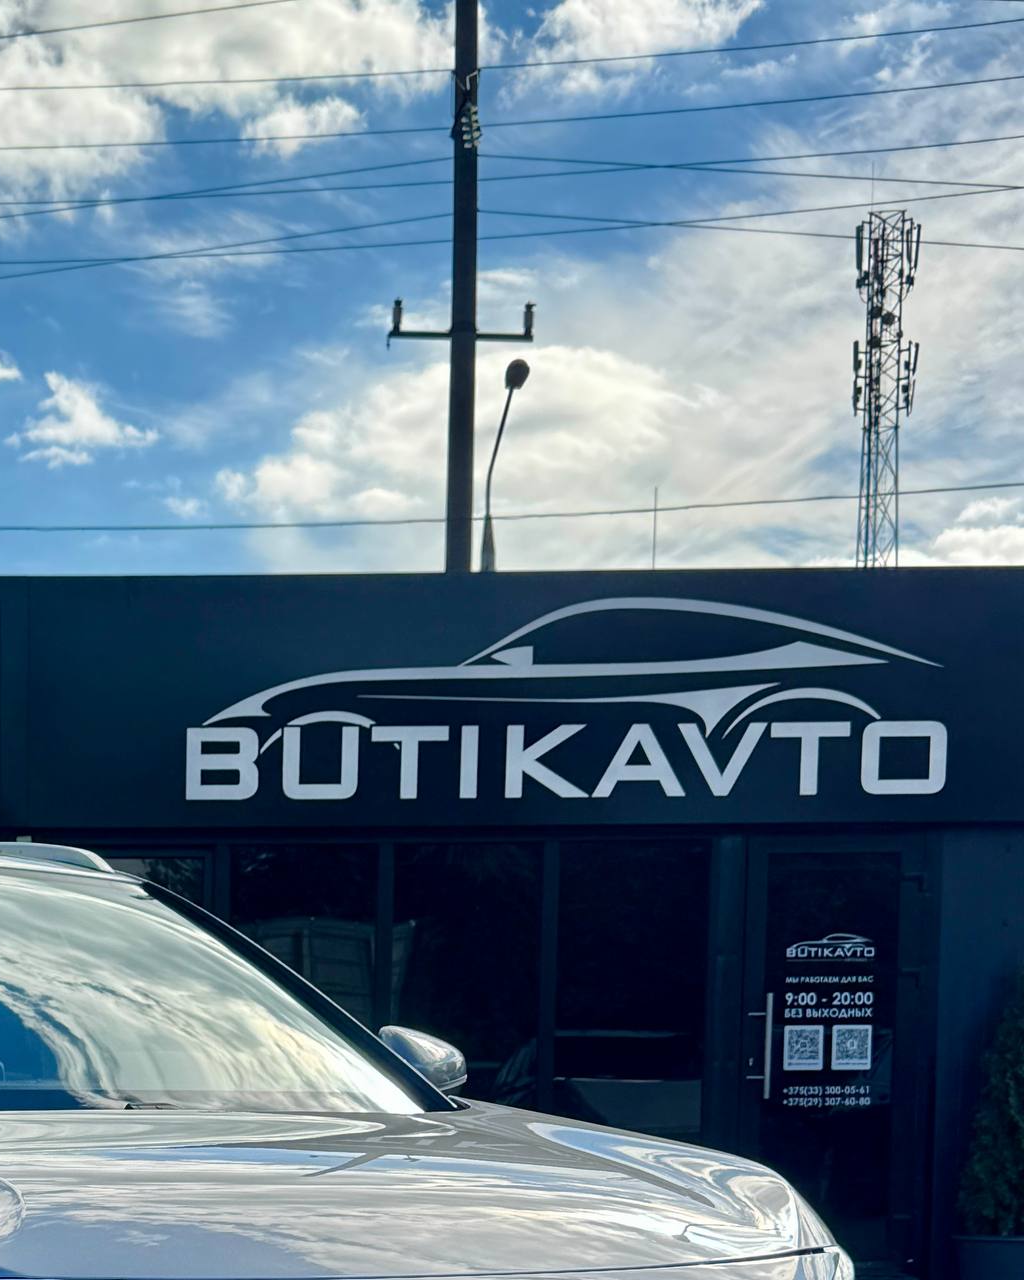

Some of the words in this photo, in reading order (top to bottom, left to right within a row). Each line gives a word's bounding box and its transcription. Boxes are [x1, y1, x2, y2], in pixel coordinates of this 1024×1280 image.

[185, 718, 948, 801] BUTIKAVTO
[786, 946, 875, 958] BUTIKAVTO
[785, 976, 800, 984] МЫ
[800, 976, 839, 984] РАБОТАЕМ
[857, 975, 874, 983] ВАС
[785, 992, 817, 1006] 9:00
[831, 991, 874, 1006] 20:00
[784, 1008, 803, 1018] БЕЗ
[805, 1007, 873, 1019] ВЫХОДНЫХ
[783, 1086, 823, 1096] +375(33)
[824, 1085, 870, 1095] 300-05-61
[783, 1097, 823, 1108] +375(29)
